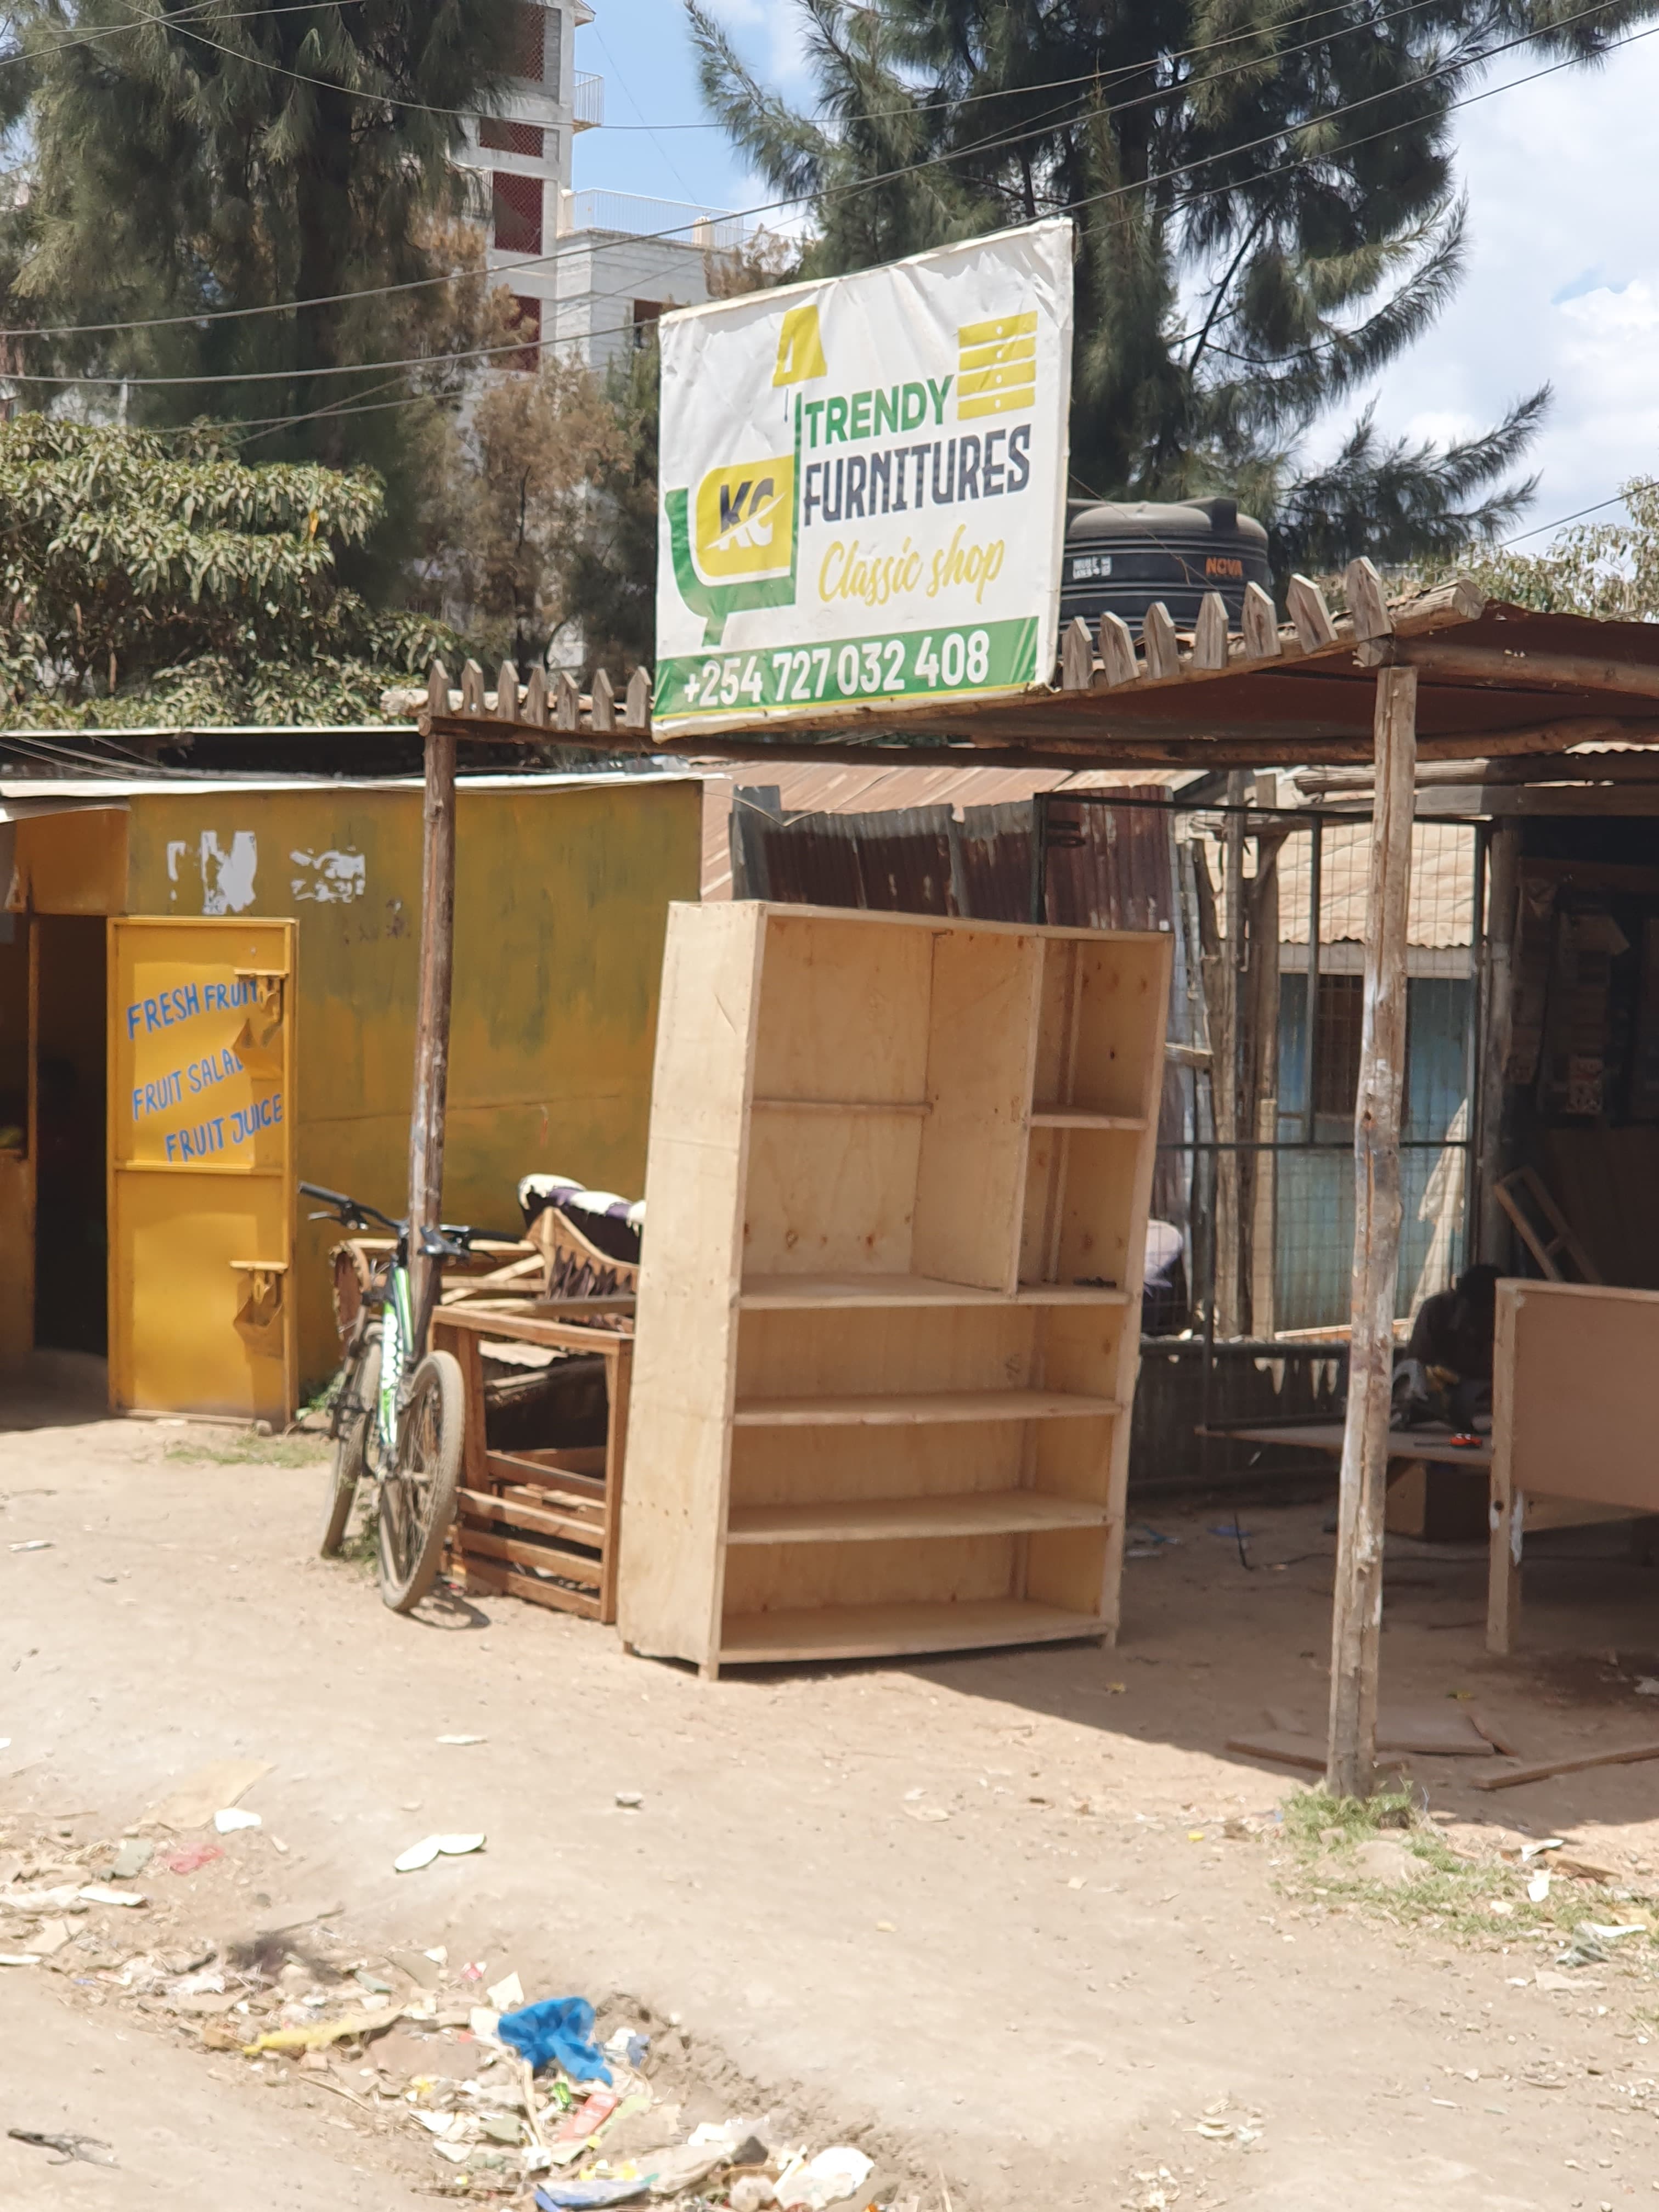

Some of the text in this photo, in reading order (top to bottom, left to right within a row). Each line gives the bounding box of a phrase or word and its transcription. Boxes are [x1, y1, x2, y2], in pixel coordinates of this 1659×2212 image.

[805, 375, 955, 448] TRENDY
[804, 424, 1031, 527] FURNITURES
[819, 524, 1005, 606] Classic shop
[1206, 557, 1243, 576] NOVA
[684, 630, 990, 707] +254 727 032 408
[127, 983, 200, 1040] FRESH
[133, 1070, 182, 1121] FRUIT
[165, 1093, 284, 1163] FRUIT JUICE
